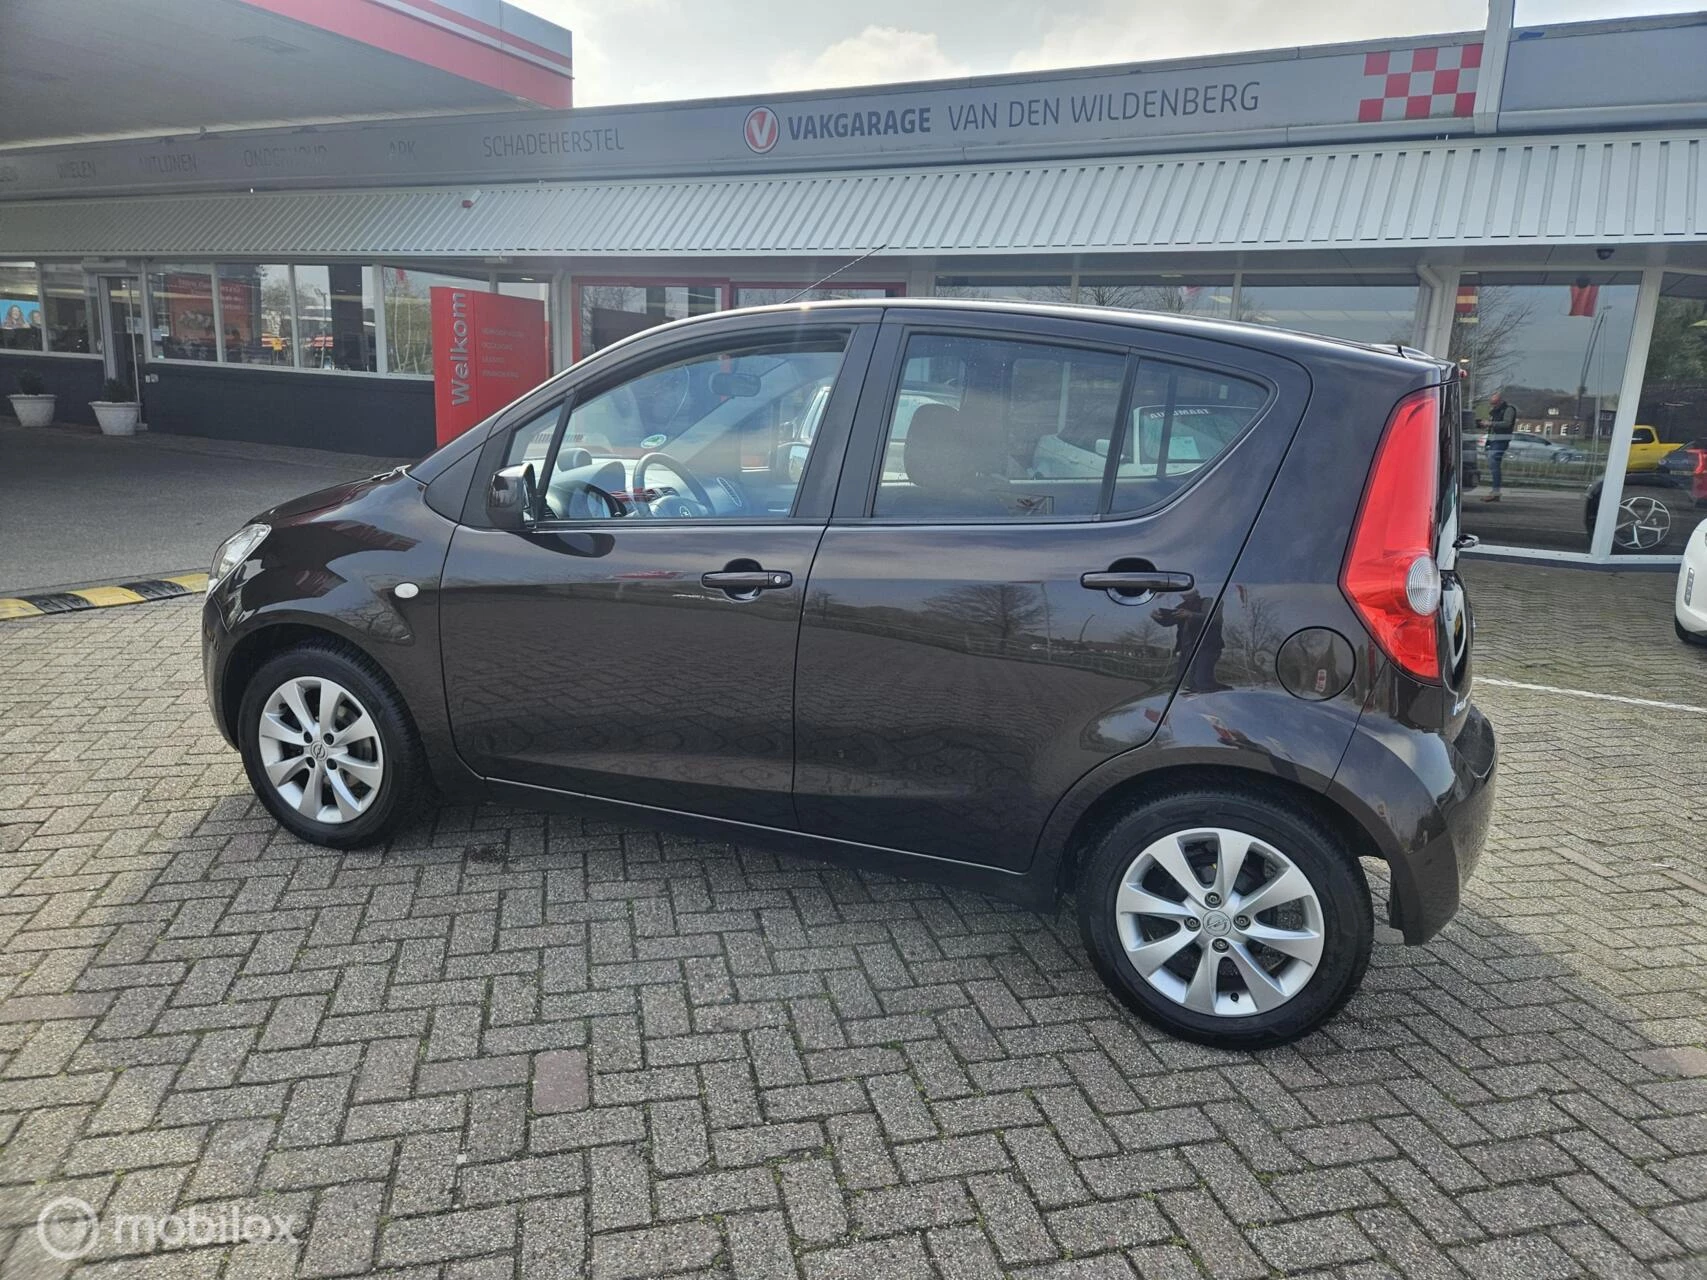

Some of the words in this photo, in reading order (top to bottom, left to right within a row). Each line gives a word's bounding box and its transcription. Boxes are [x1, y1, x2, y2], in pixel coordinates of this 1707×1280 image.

[788, 106, 931, 141] VAKGARAGE
[948, 102, 997, 132] VAN
[1008, 98, 1060, 128] DEN
[1071, 80, 1261, 124] WILDENBERG
[482, 127, 625, 158] SCHADEHERSTEL
[450, 292, 471, 406] Welkom
[1150, 408, 1209, 419] AUOMAAT
